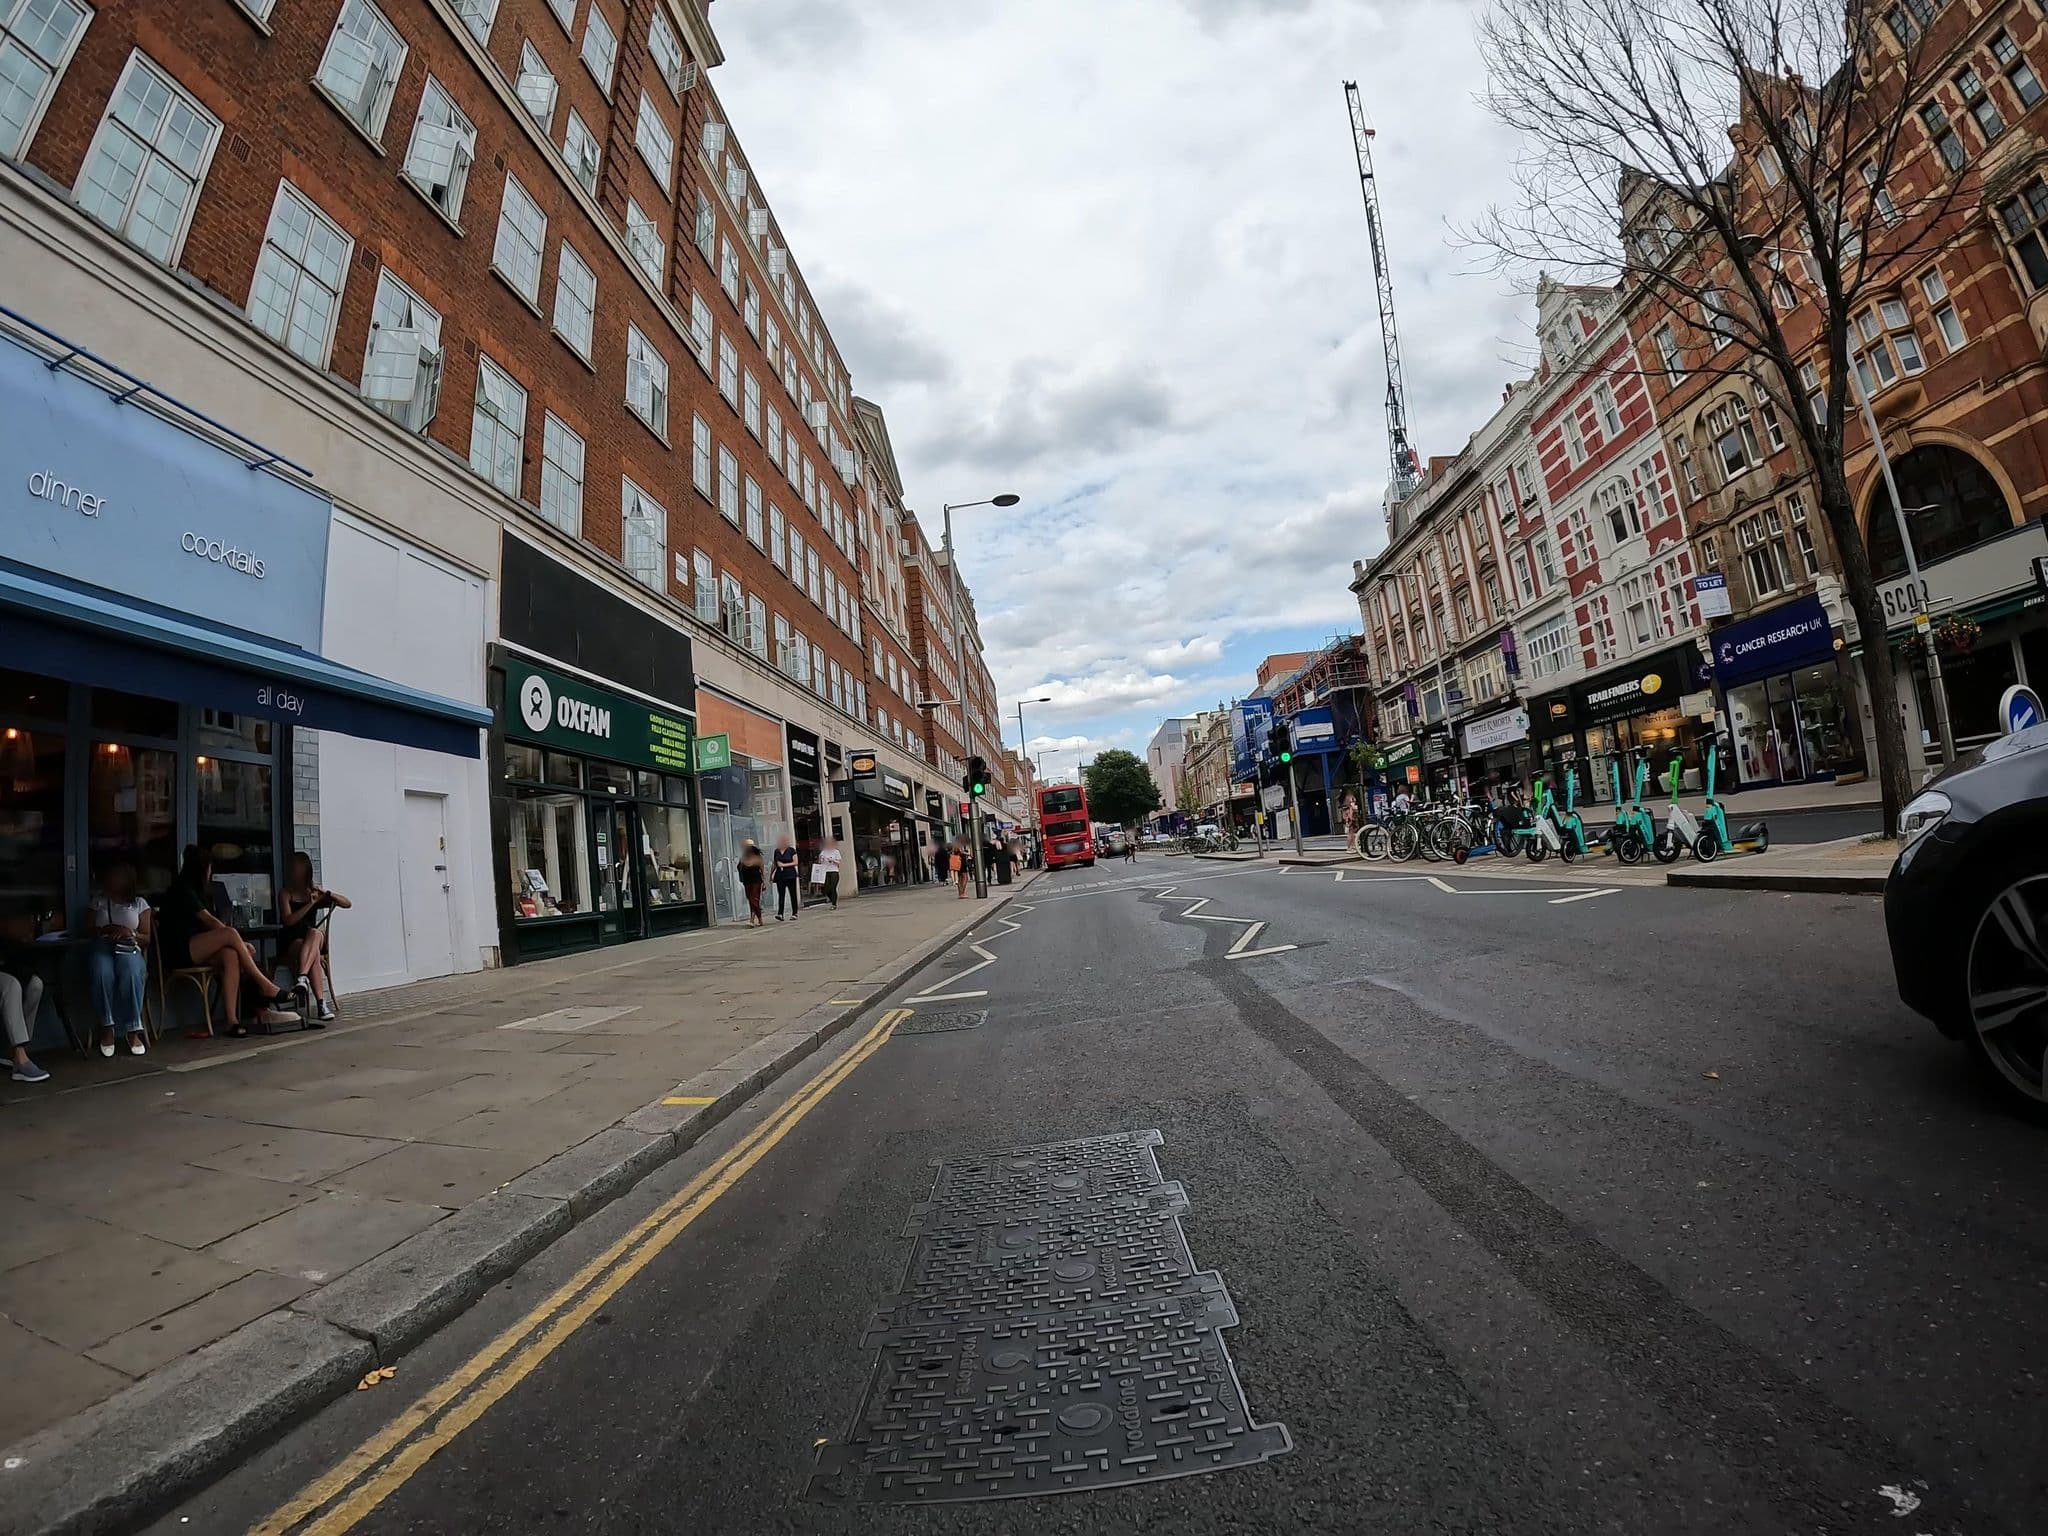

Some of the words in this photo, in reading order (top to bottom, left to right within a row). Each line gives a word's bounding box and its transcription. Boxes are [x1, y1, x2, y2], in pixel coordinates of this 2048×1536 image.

[28, 469, 107, 518] dinner
[181, 532, 266, 580] cocktails
[1697, 581, 1709, 589] TO
[1709, 579, 1723, 587] LET
[1735, 637, 1766, 655] CANCER
[1767, 623, 1808, 644] RESEARCH
[1809, 618, 1822, 631] UK
[256, 685, 272, 706] all
[276, 688, 305, 716] day
[1587, 680, 1640, 704] TRAILFINDERS
[557, 695, 610, 738] OXFAM
[1493, 715, 1512, 729] MORTA
[1117, 1376, 1145, 1452] vodafone
